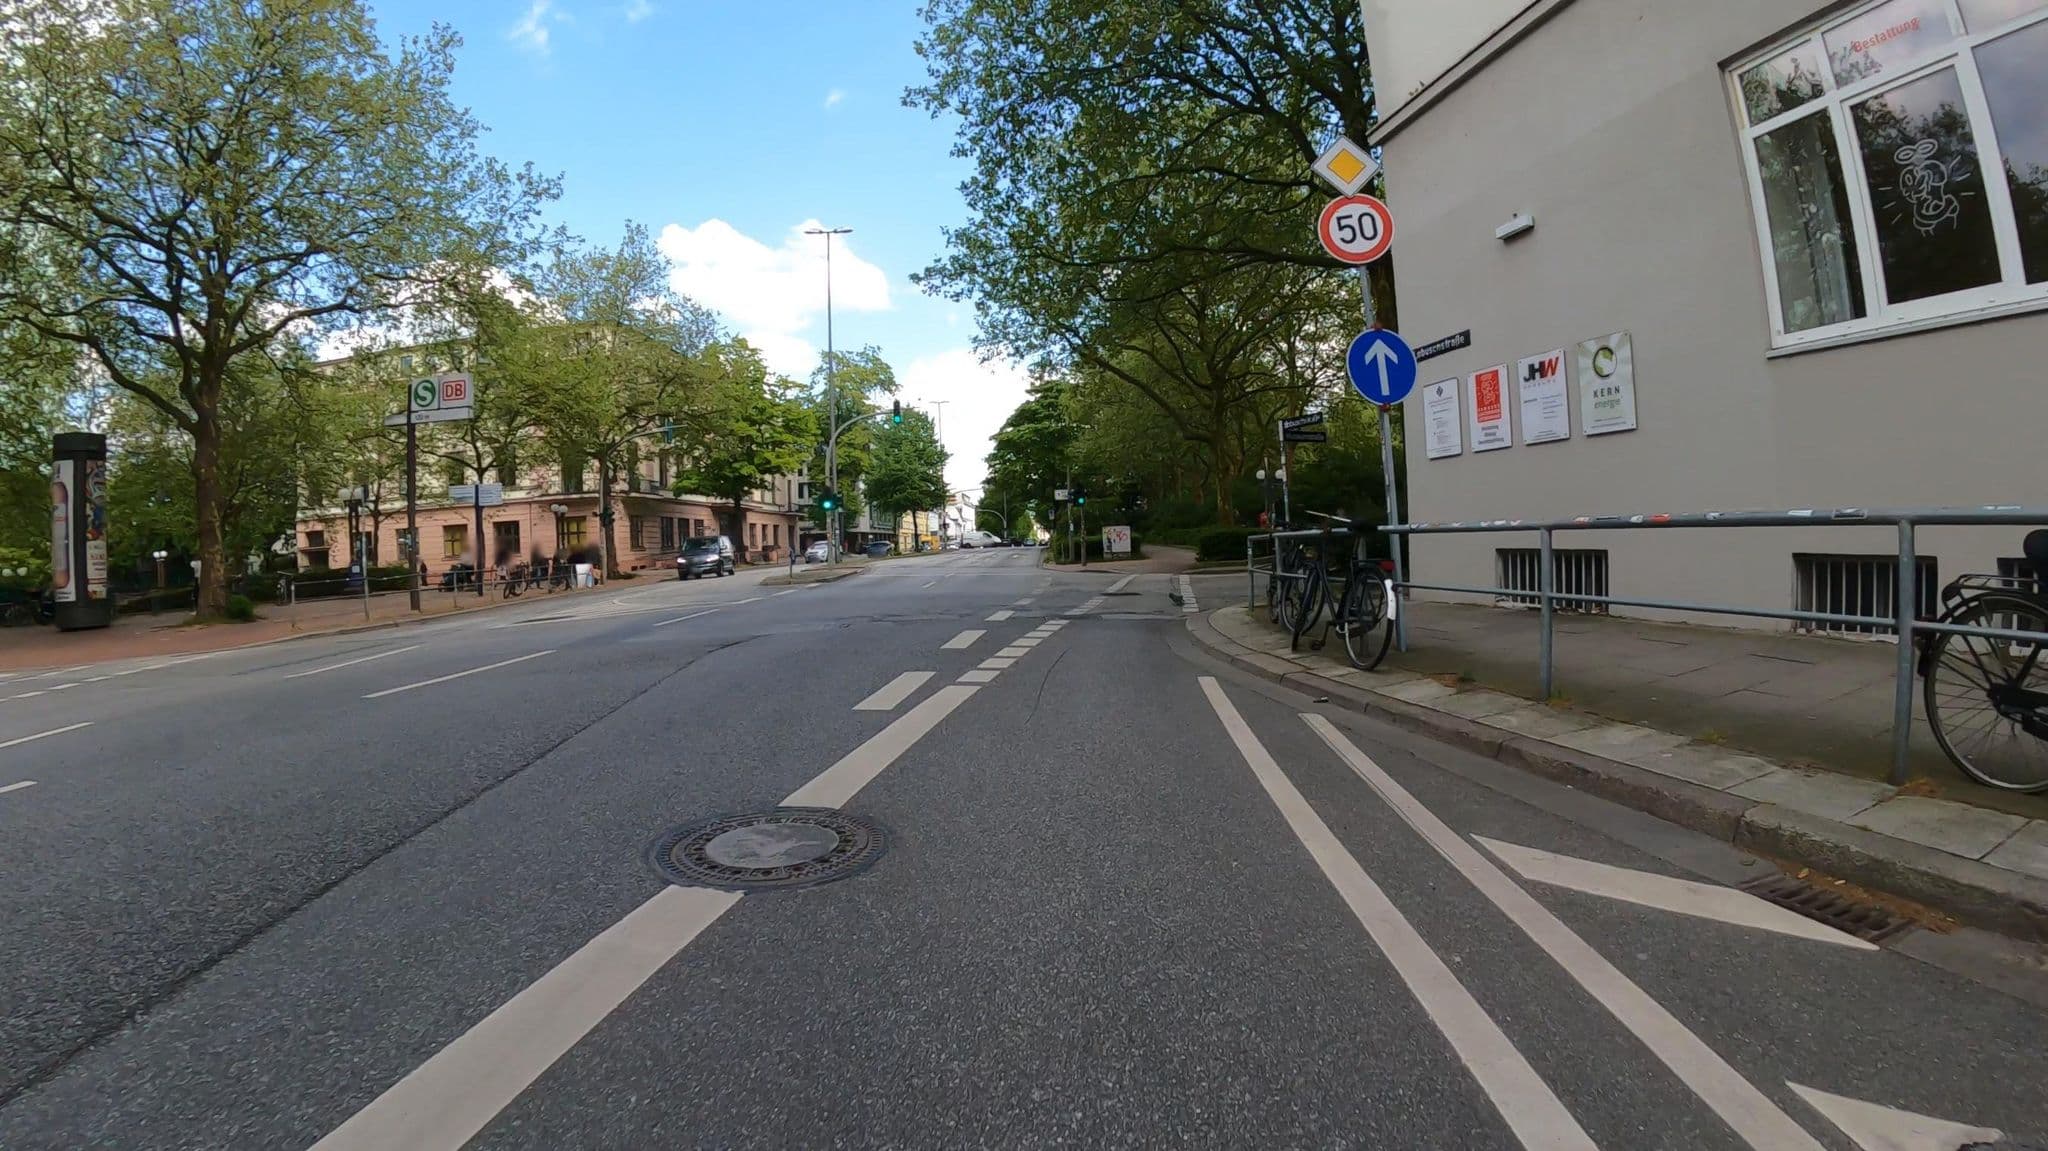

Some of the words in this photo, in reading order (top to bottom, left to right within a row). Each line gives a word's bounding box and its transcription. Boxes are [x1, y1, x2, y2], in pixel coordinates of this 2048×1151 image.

[1852, 16, 1920, 53] Bestattung
[1336, 212, 1378, 244] 50
[1523, 356, 1560, 382] JHW
[445, 383, 463, 398] DB
[1593, 385, 1620, 398] KERN
